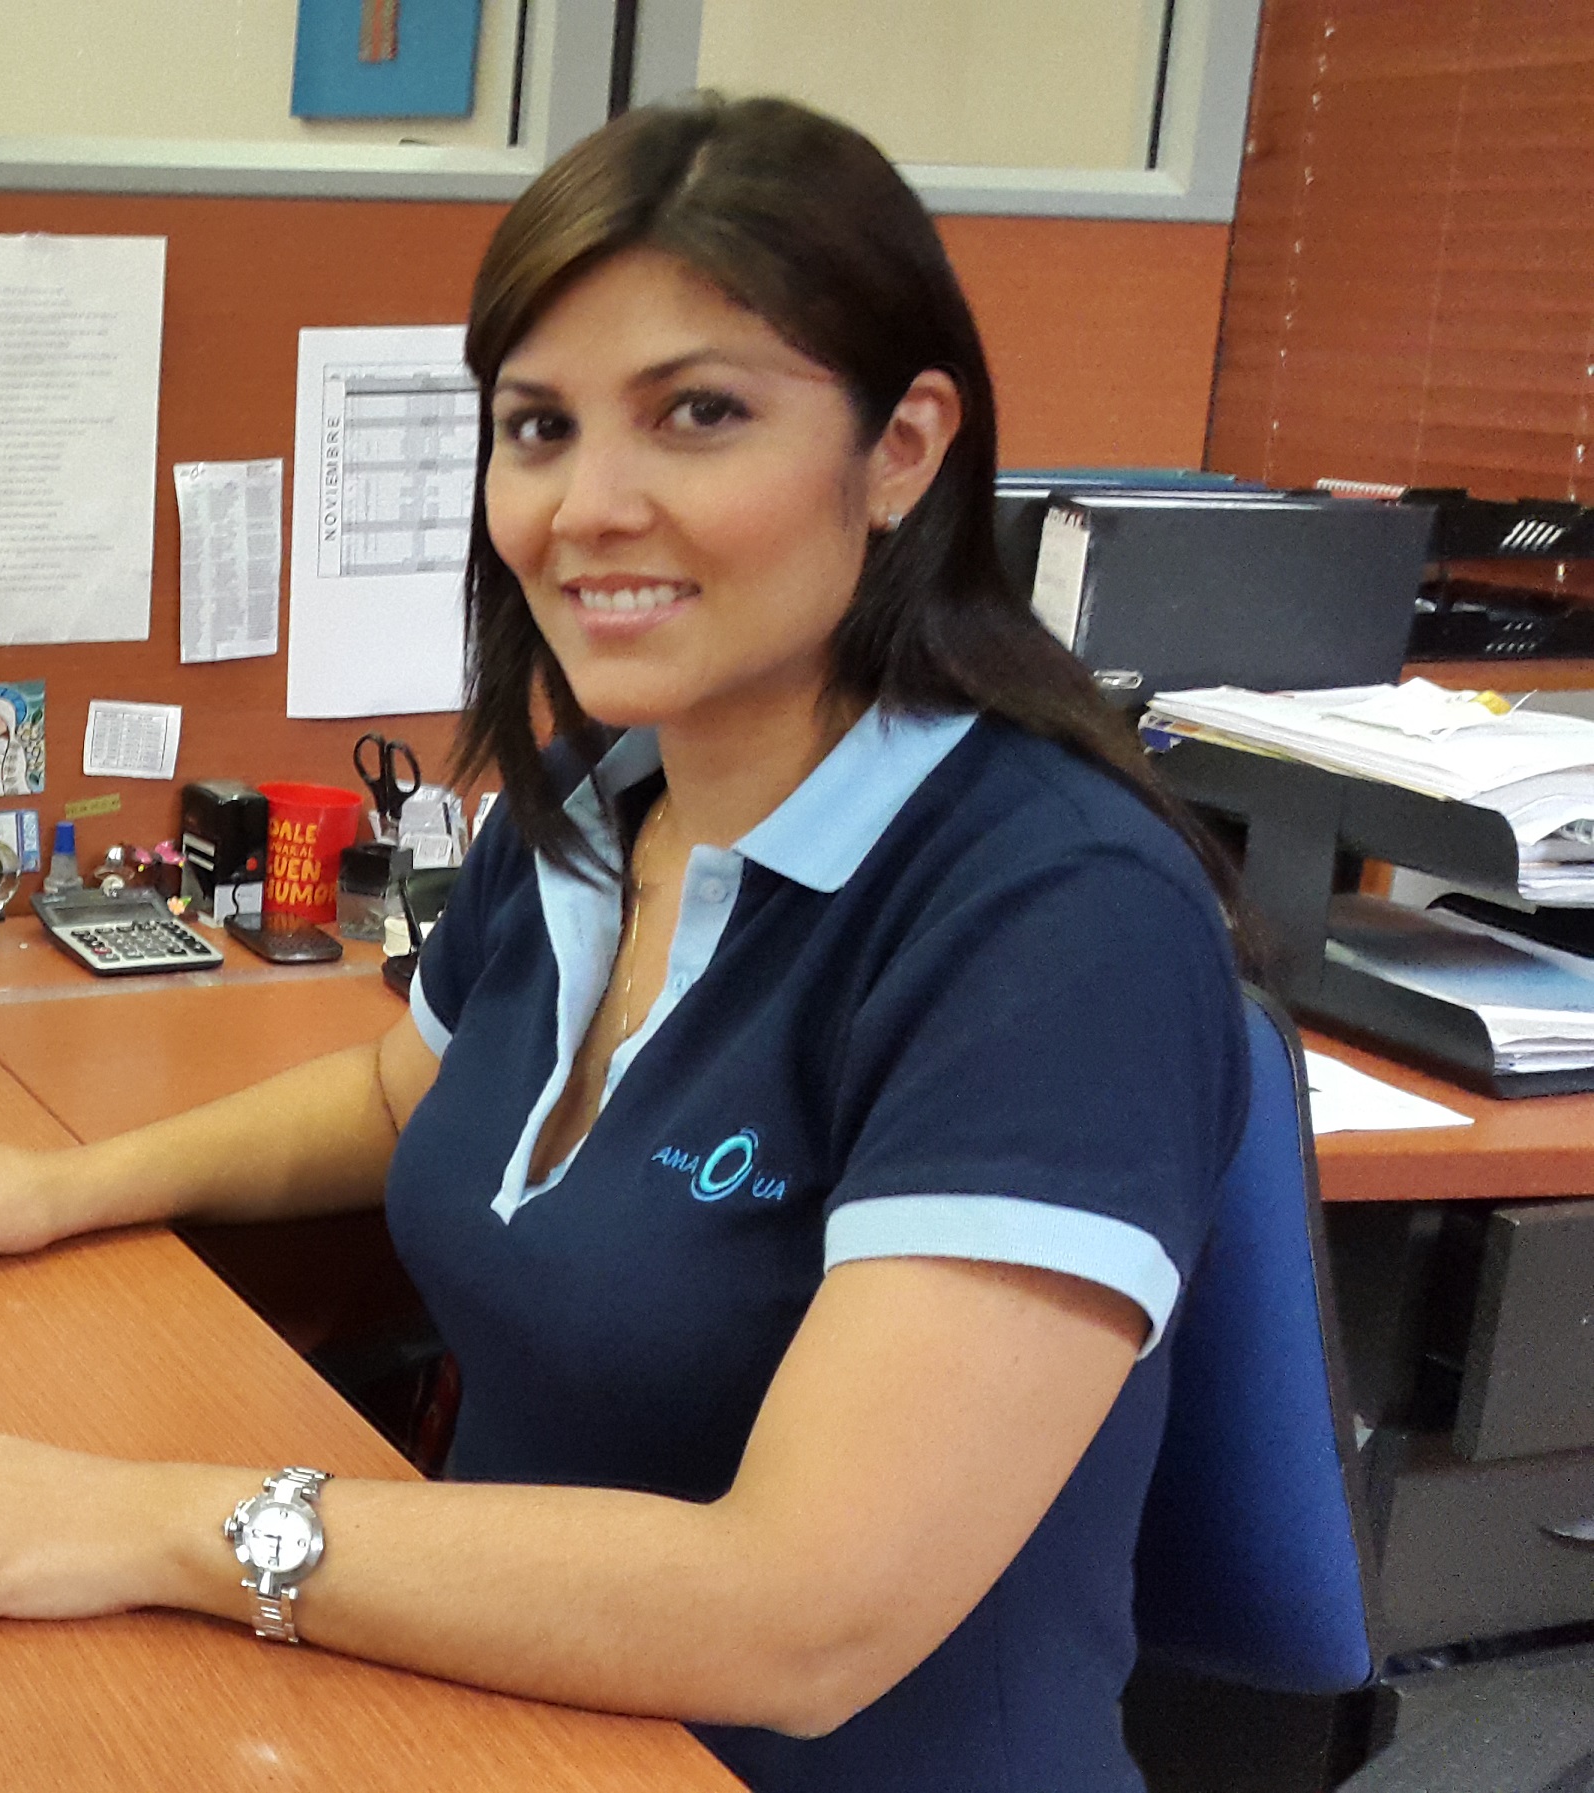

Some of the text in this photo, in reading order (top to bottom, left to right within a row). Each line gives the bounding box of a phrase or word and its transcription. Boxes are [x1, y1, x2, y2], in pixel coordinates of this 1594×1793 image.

[324, 416, 341, 541] NOVIEMBRE
[269, 817, 318, 844] DALE
[267, 854, 322, 882] UEN
